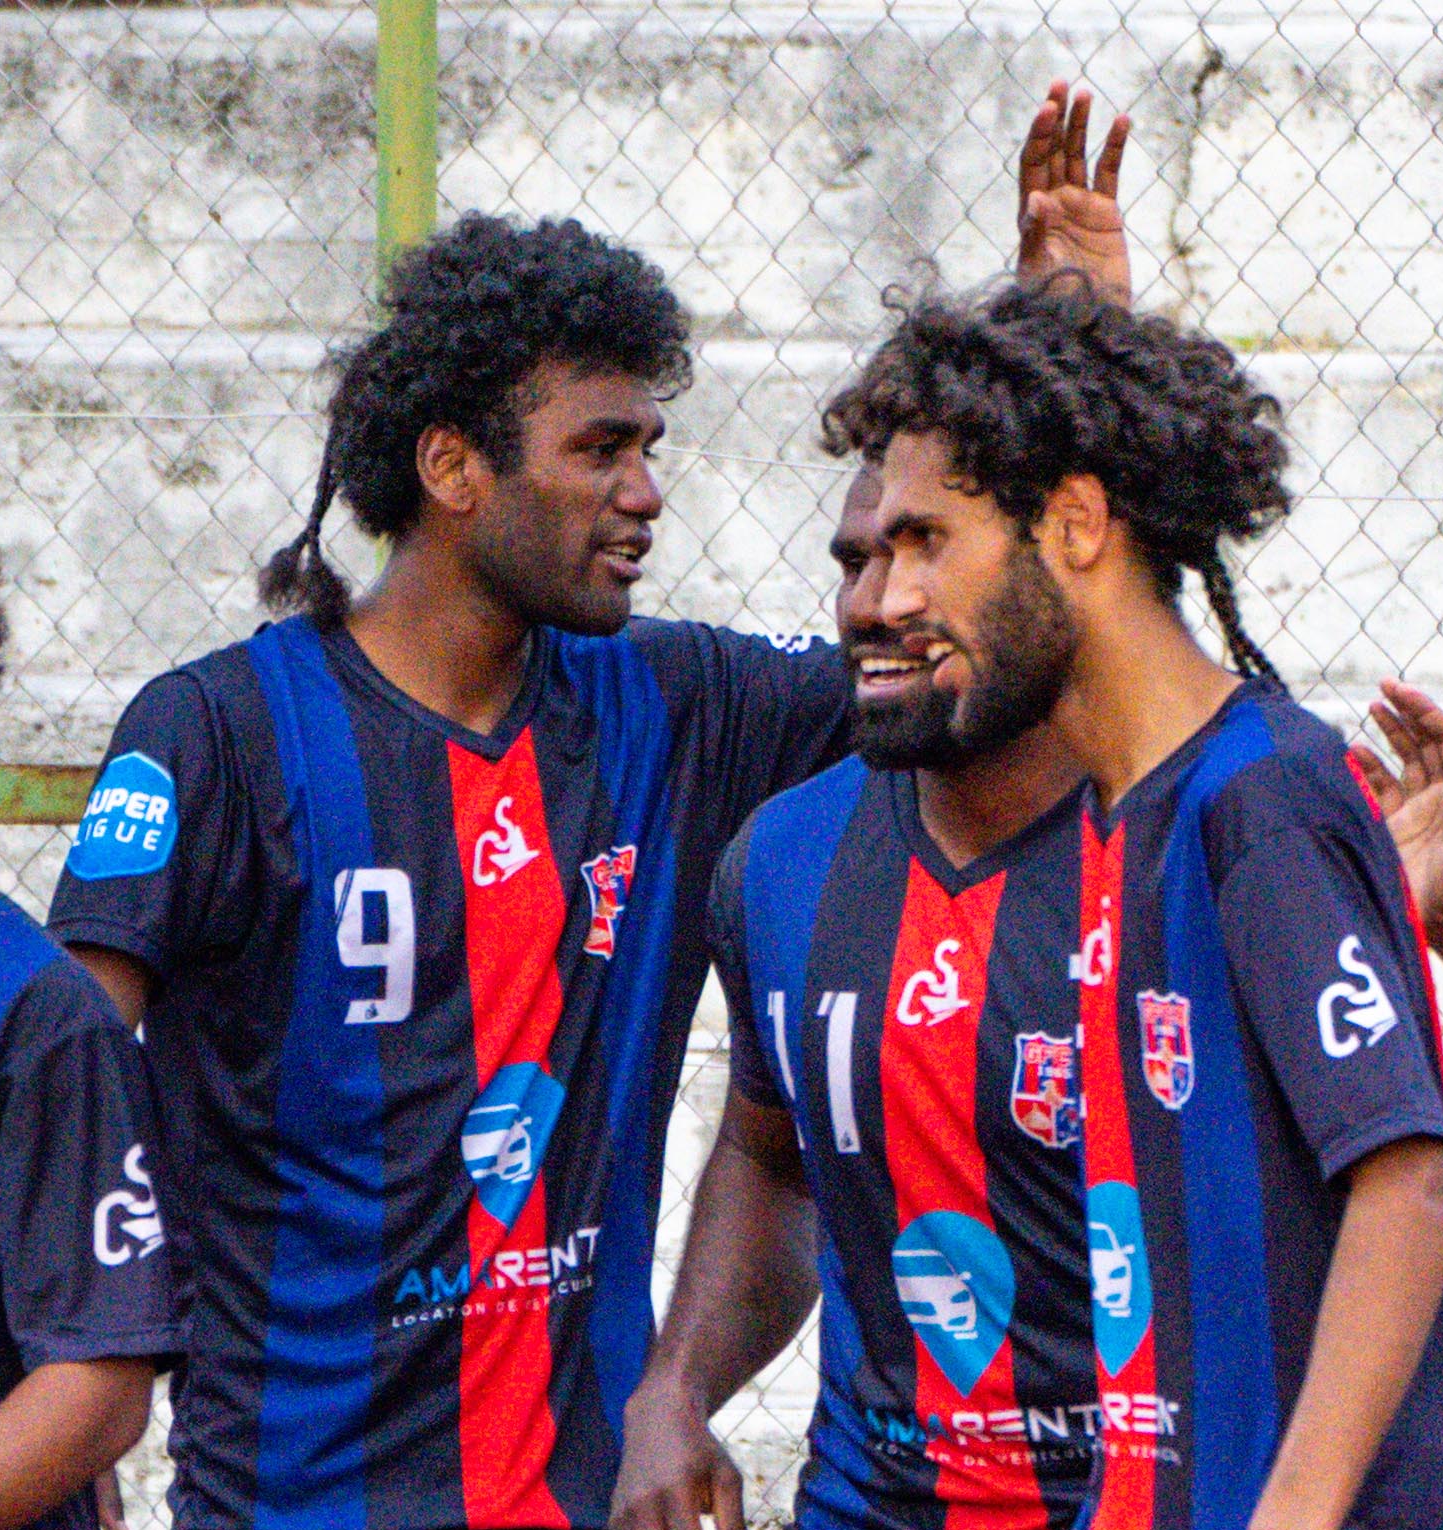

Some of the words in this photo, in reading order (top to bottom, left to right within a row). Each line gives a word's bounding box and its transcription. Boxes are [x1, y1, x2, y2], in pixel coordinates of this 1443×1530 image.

[83, 787, 170, 825] UPER
[334, 868, 415, 1024] 9
[767, 991, 861, 1153] 11
